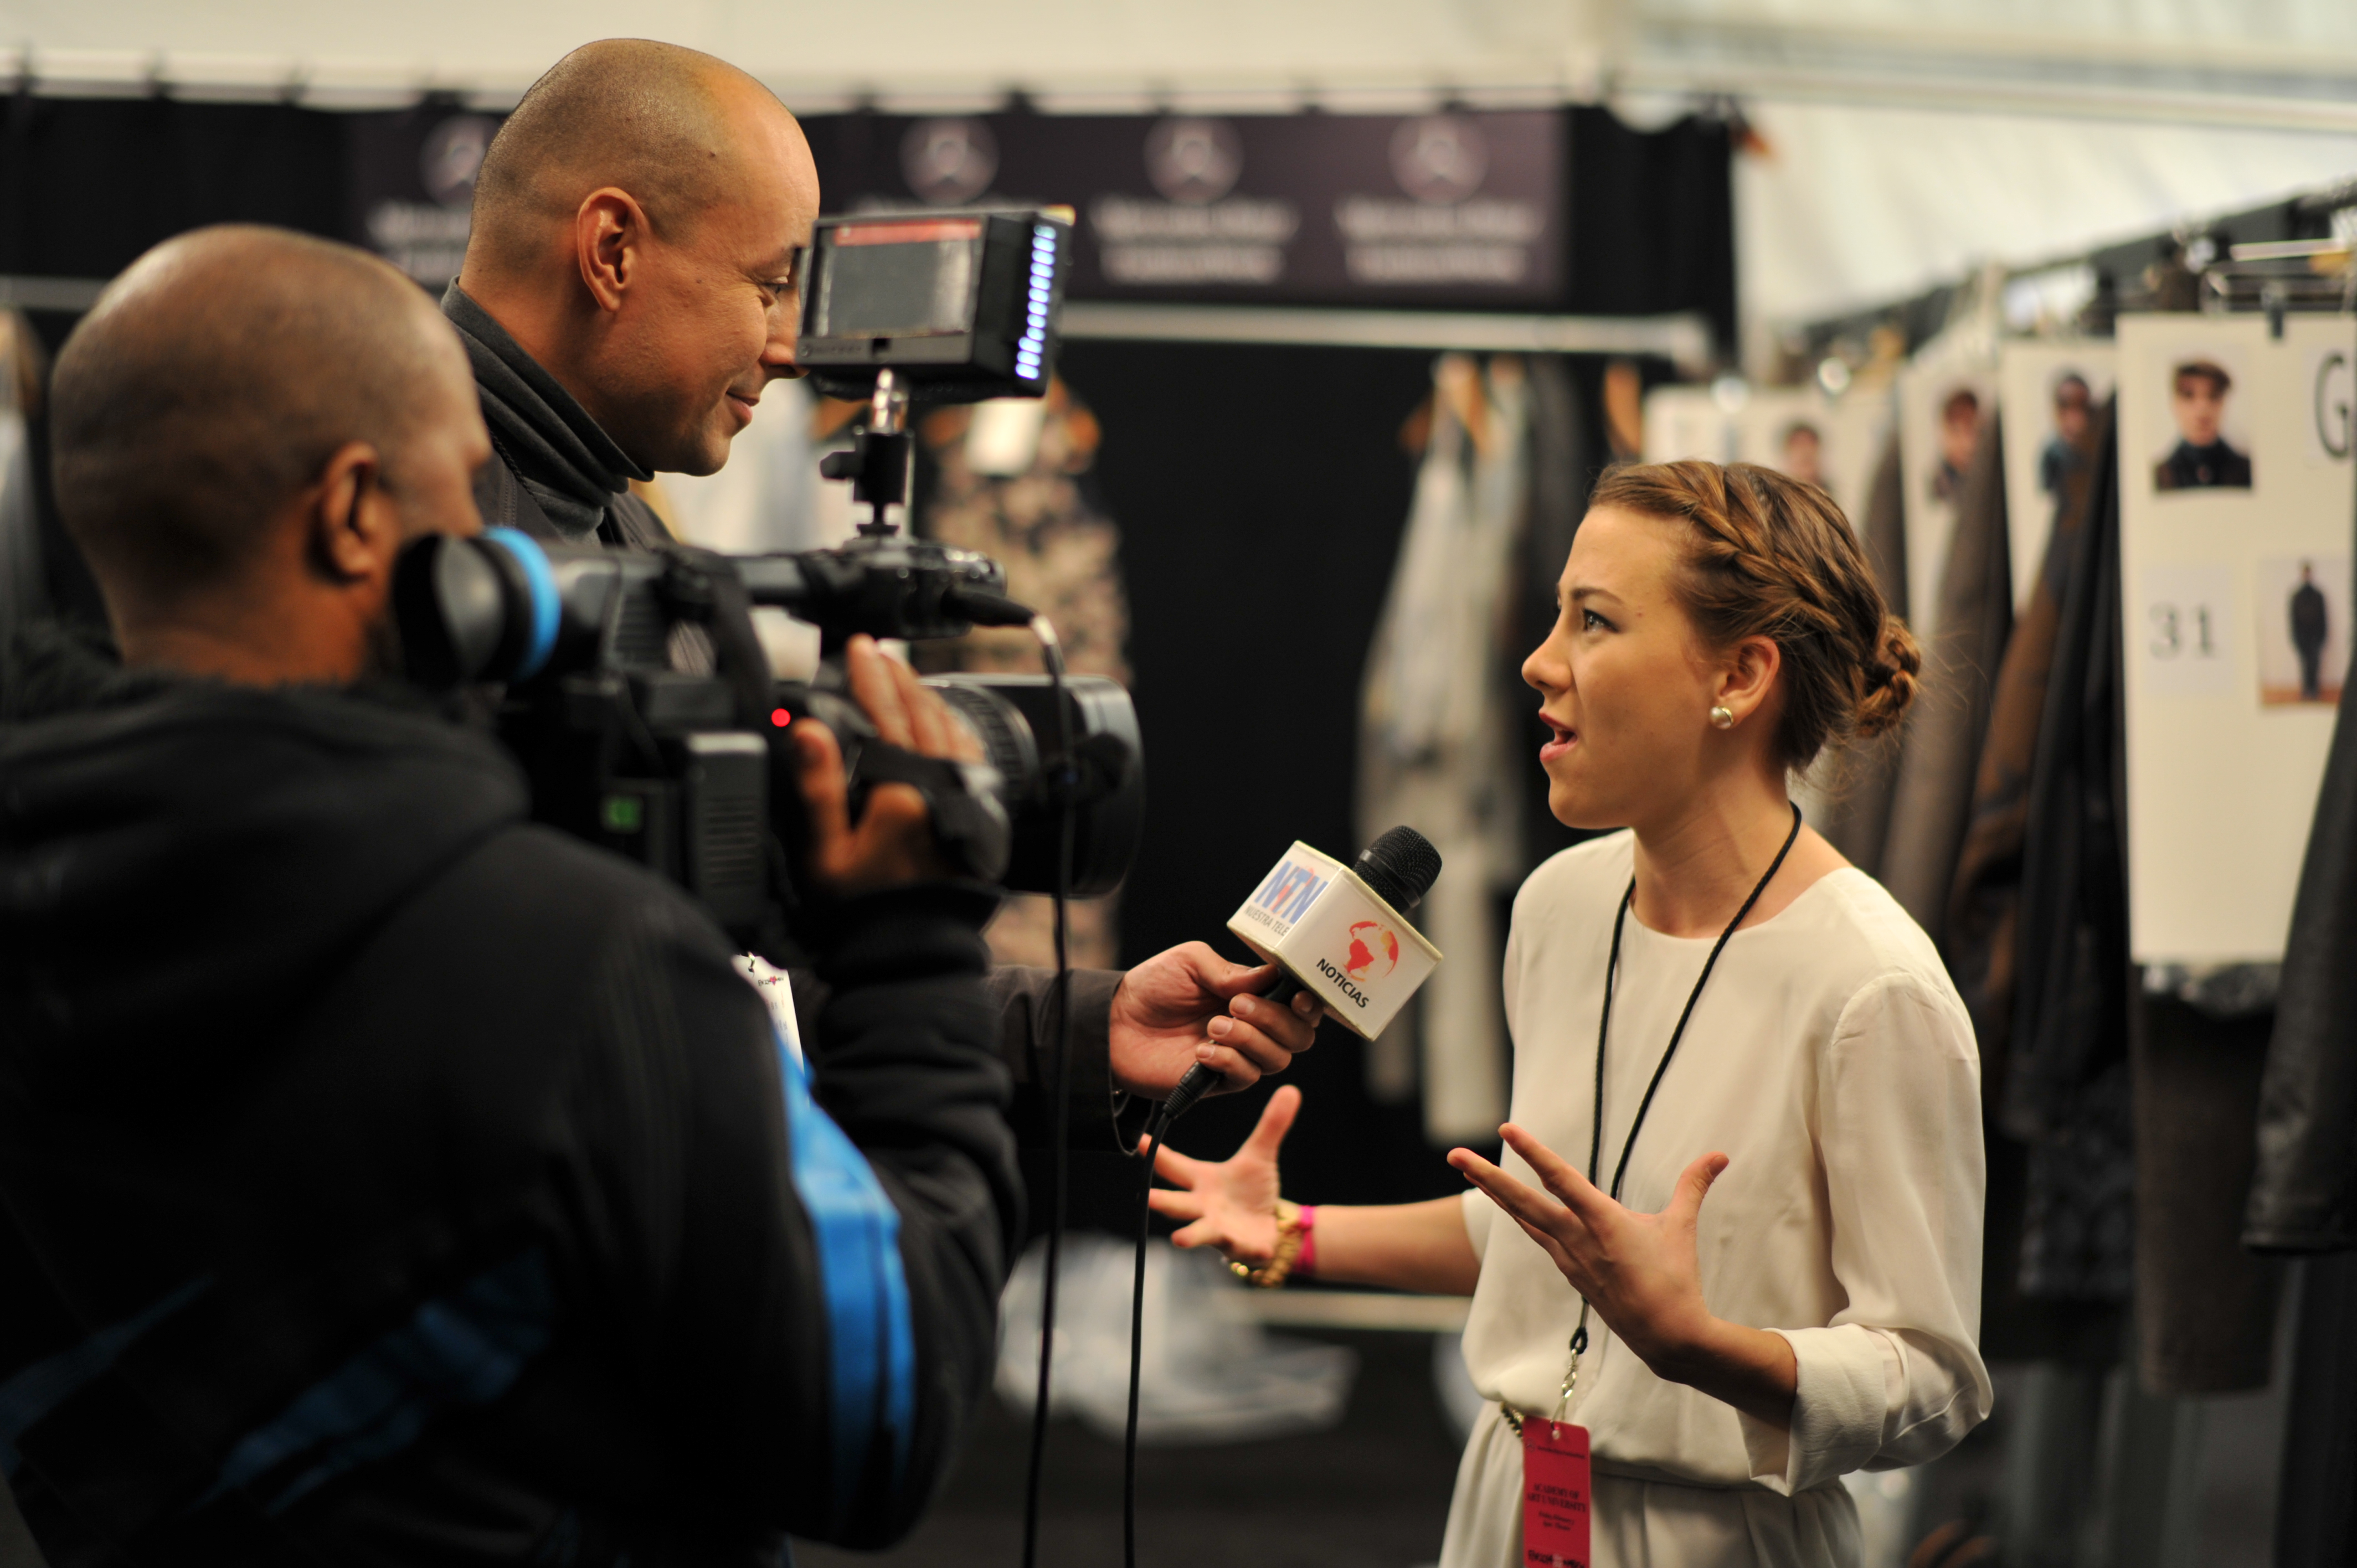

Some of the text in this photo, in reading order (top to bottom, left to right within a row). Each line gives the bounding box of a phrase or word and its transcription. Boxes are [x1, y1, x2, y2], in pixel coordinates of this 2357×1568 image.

[2149, 602, 2216, 659] 31
[1244, 905, 1275, 927] NUESTRA
[1316, 958, 1369, 1008] NOTICIAS
